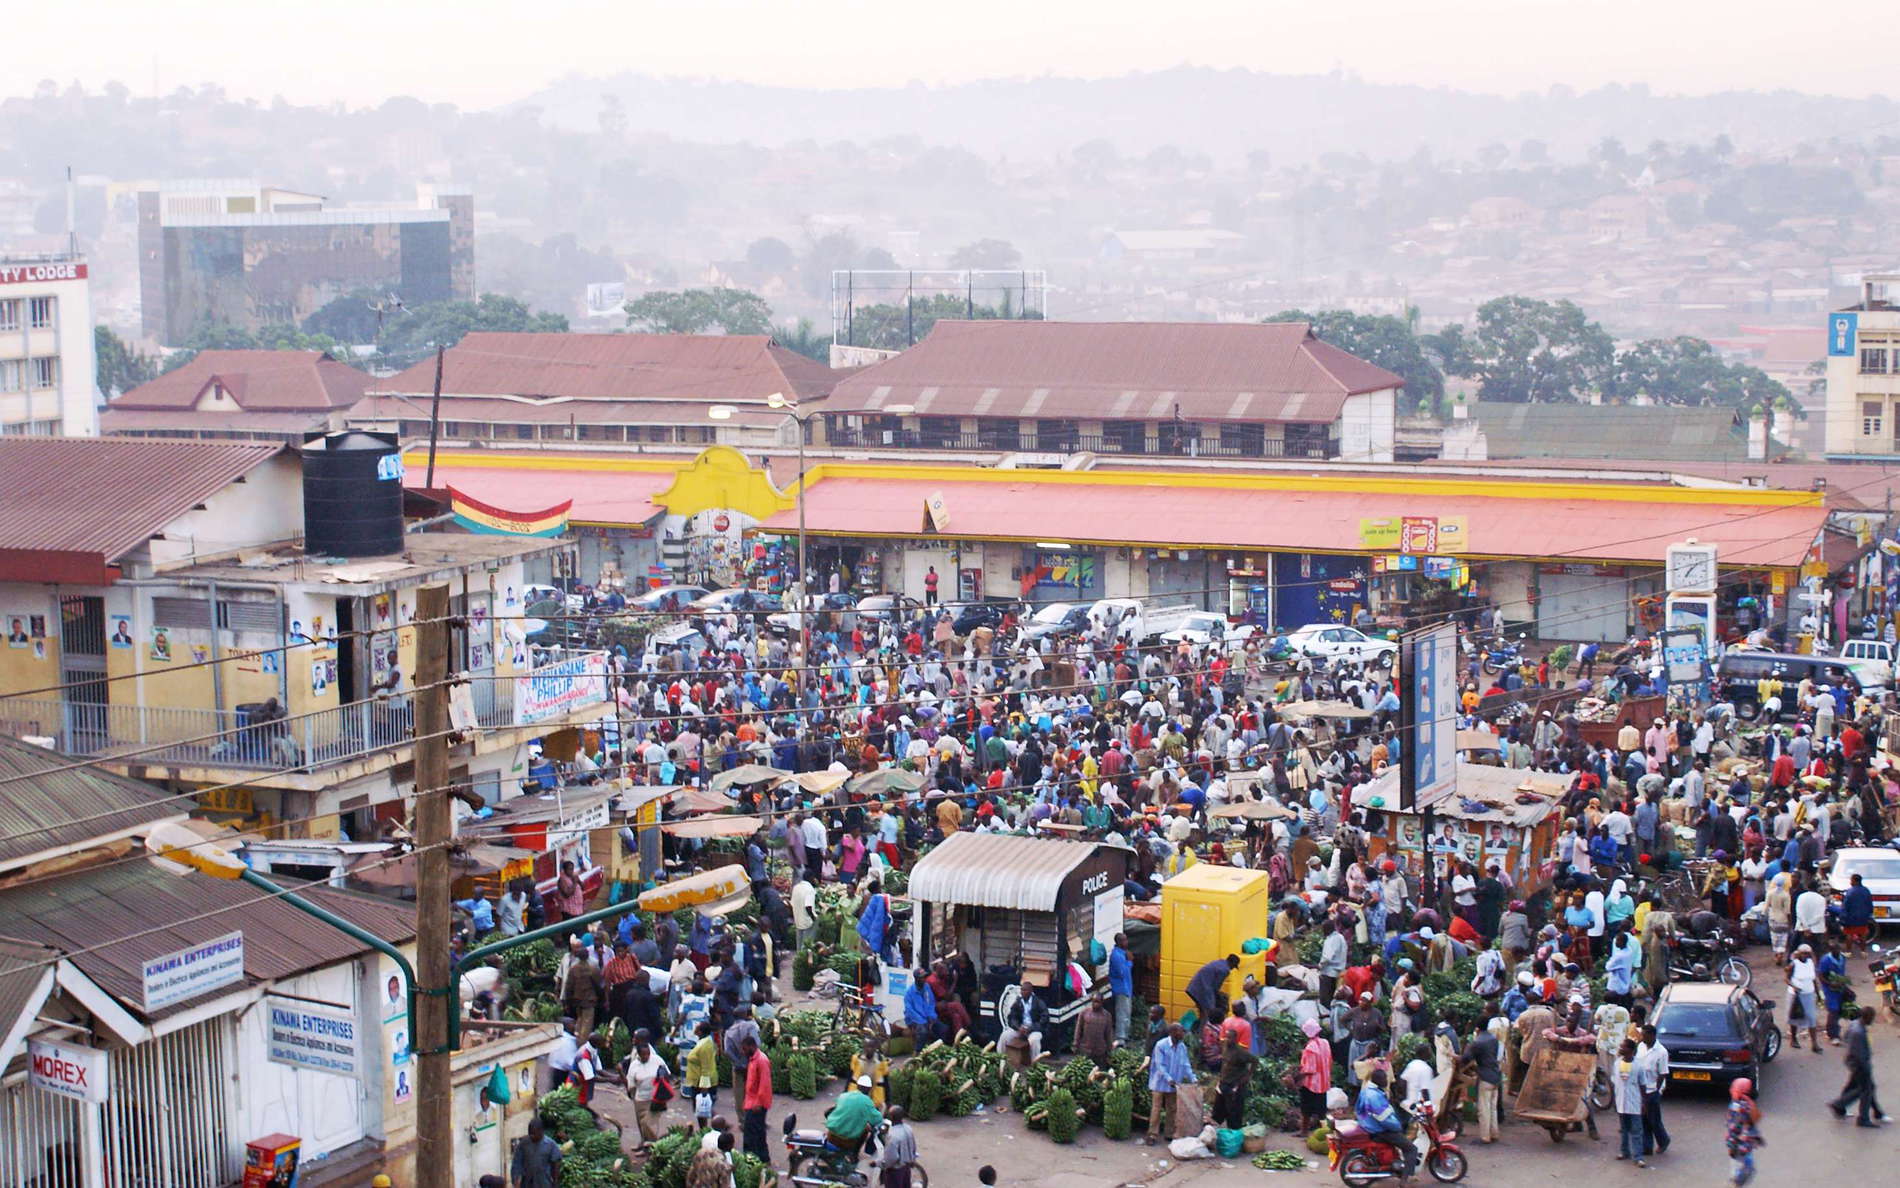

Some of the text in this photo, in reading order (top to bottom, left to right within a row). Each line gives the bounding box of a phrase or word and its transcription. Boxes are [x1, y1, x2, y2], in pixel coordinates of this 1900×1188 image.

[26, 264, 77, 281] LODGE
[537, 678, 573, 702] PHILLIP
[1082, 871, 1108, 895] POLICE
[184, 937, 241, 965] ENTERPRISES
[303, 1014, 353, 1040] ENTERPRISES
[33, 1054, 88, 1088] MOREX
